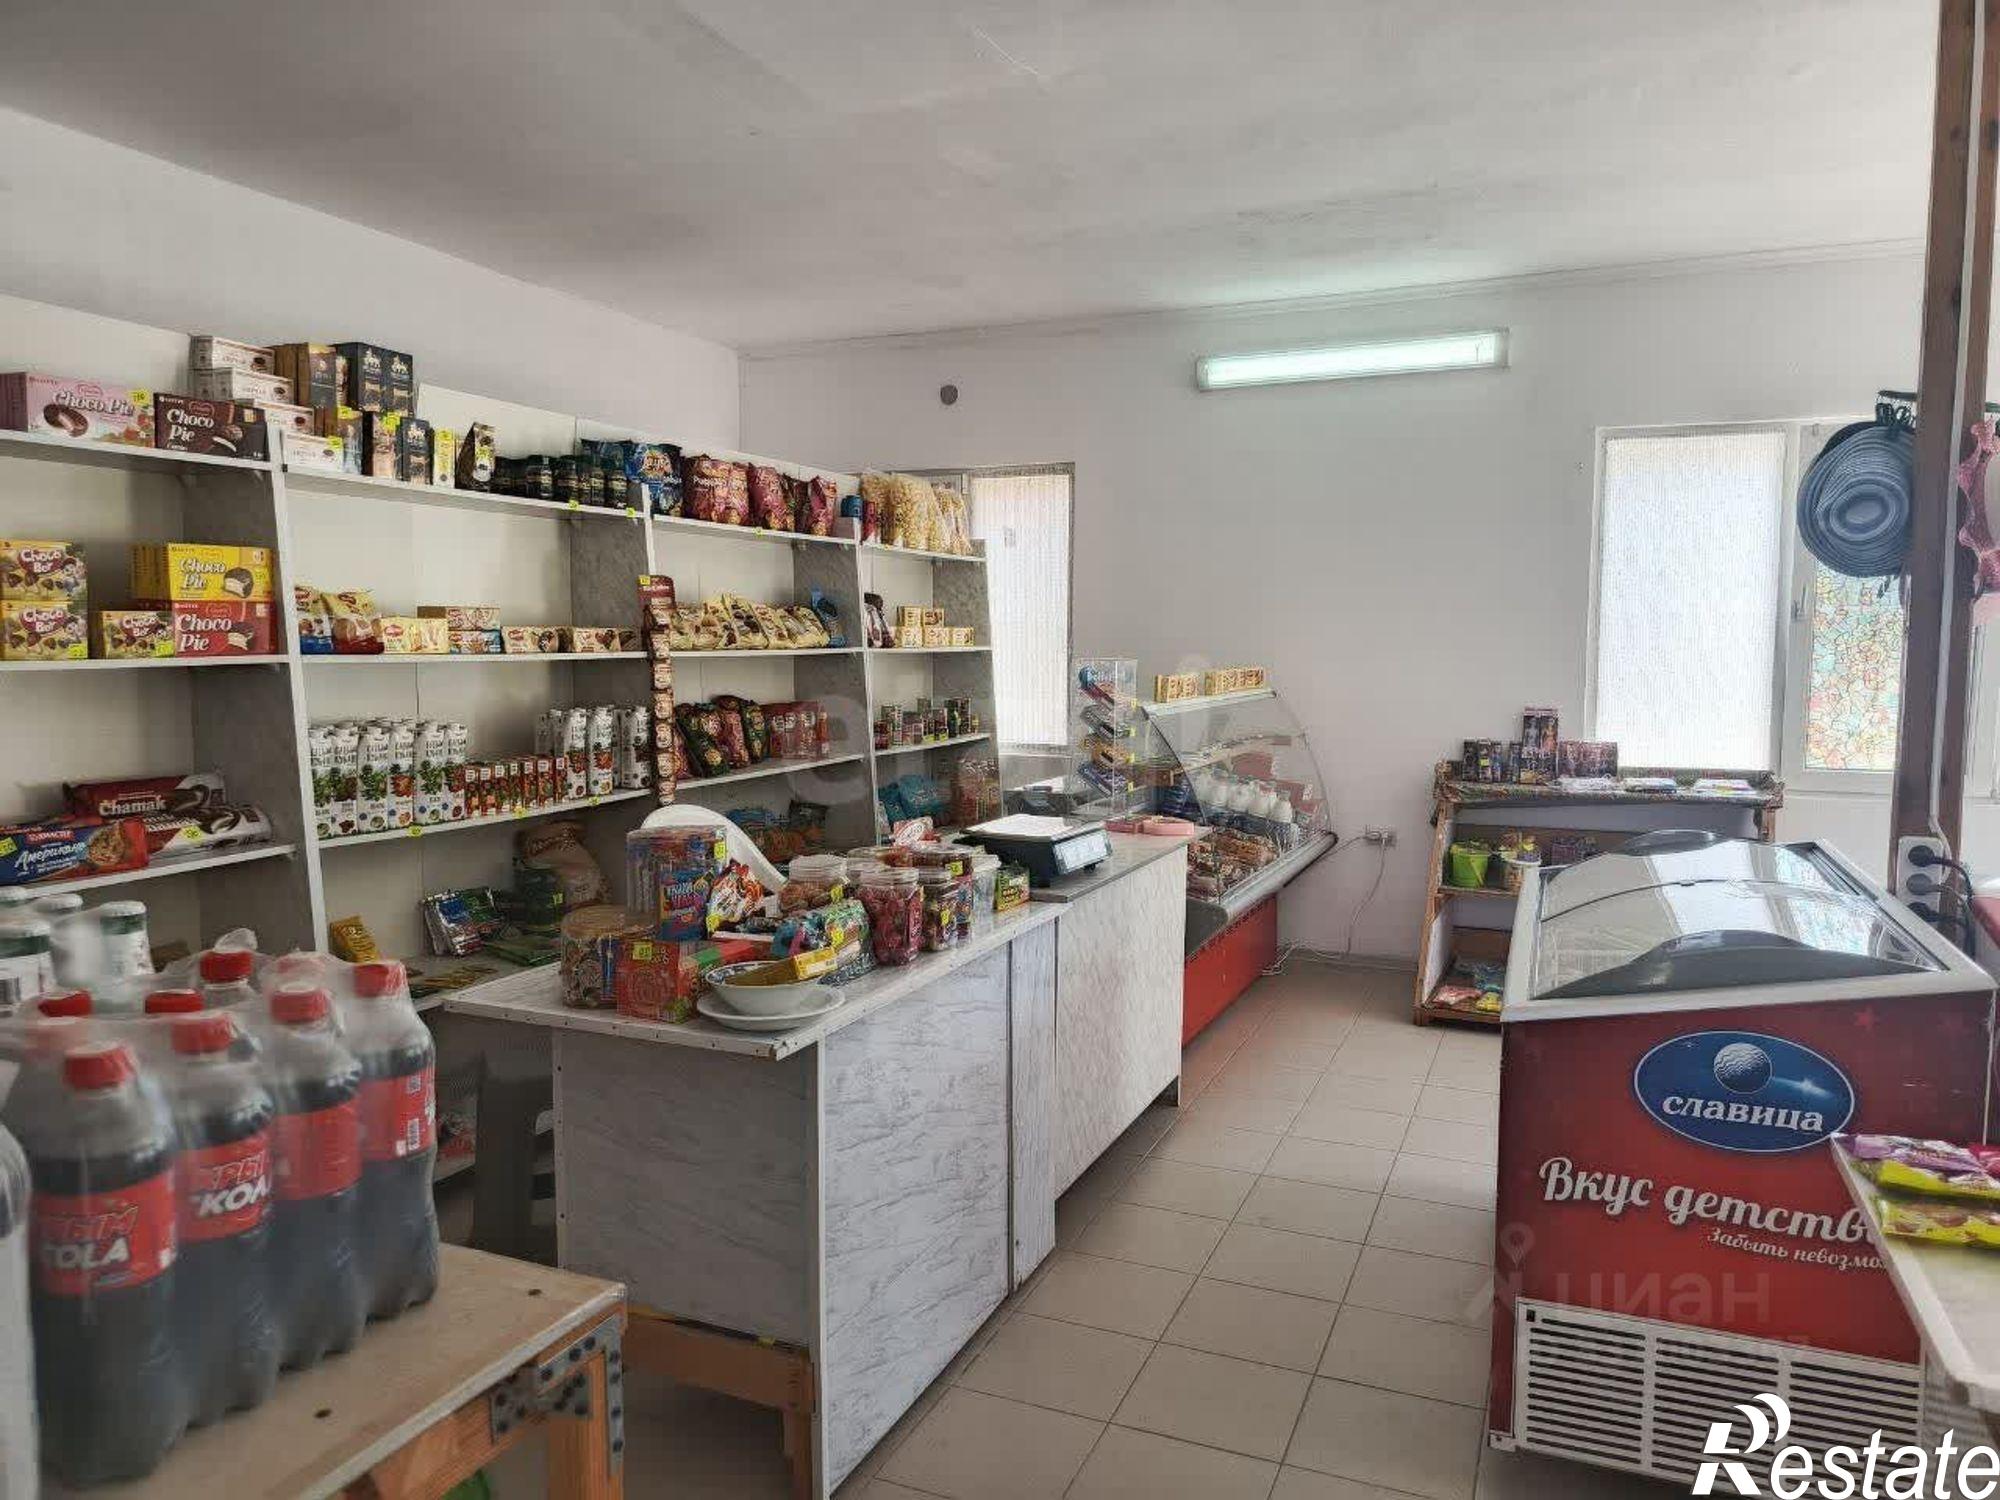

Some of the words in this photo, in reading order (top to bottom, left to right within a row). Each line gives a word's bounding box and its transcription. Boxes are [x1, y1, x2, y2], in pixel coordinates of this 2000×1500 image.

[54, 389, 104, 413] Choco
[104, 399, 135, 417] Pie
[166, 408, 215, 429] Choco
[169, 424, 196, 442] Pie
[20, 549, 62, 562] Choco
[180, 558, 227, 573] Choco
[183, 574, 208, 590] Pie
[22, 607, 64, 623] Choco
[121, 616, 158, 629] Choco
[178, 613, 232, 632] Choco
[179, 633, 210, 652] Pie
[99, 794, 166, 816] Chamak
[1662, 1096, 1823, 1132] славица
[1538, 1157, 1654, 1215] Вкус
[1706, 1227, 1789, 1258] Забыть
[1793, 1248, 1886, 1271] невозмо
